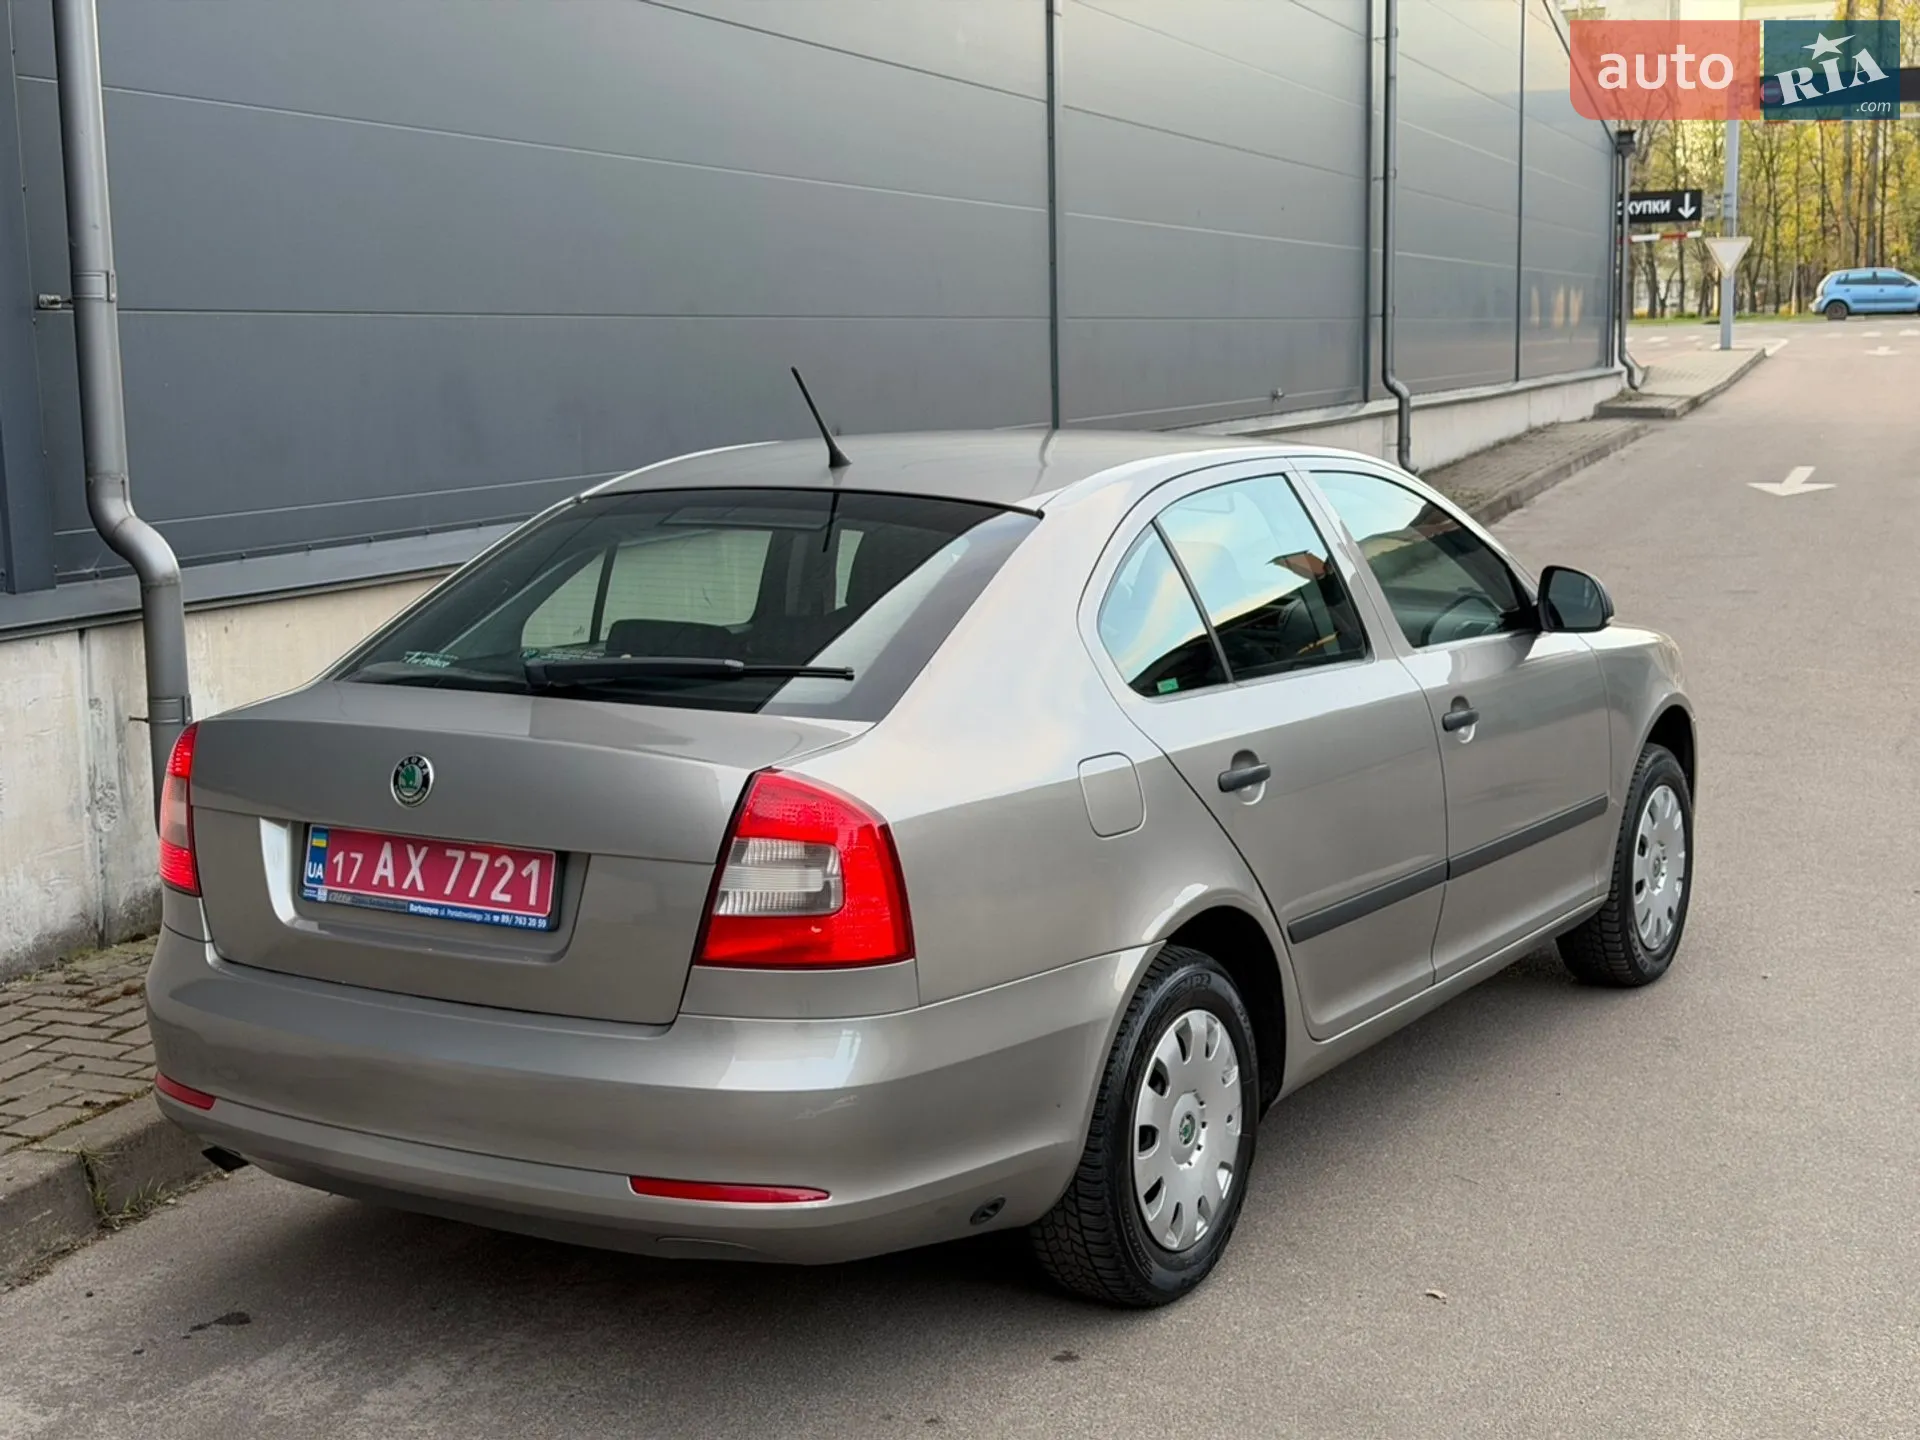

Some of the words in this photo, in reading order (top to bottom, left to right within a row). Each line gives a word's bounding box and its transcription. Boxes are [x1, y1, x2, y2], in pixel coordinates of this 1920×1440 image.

[307, 860, 324, 880] UA
[332, 851, 365, 885] 17
[371, 841, 429, 892] AX
[443, 849, 542, 906] 7721
